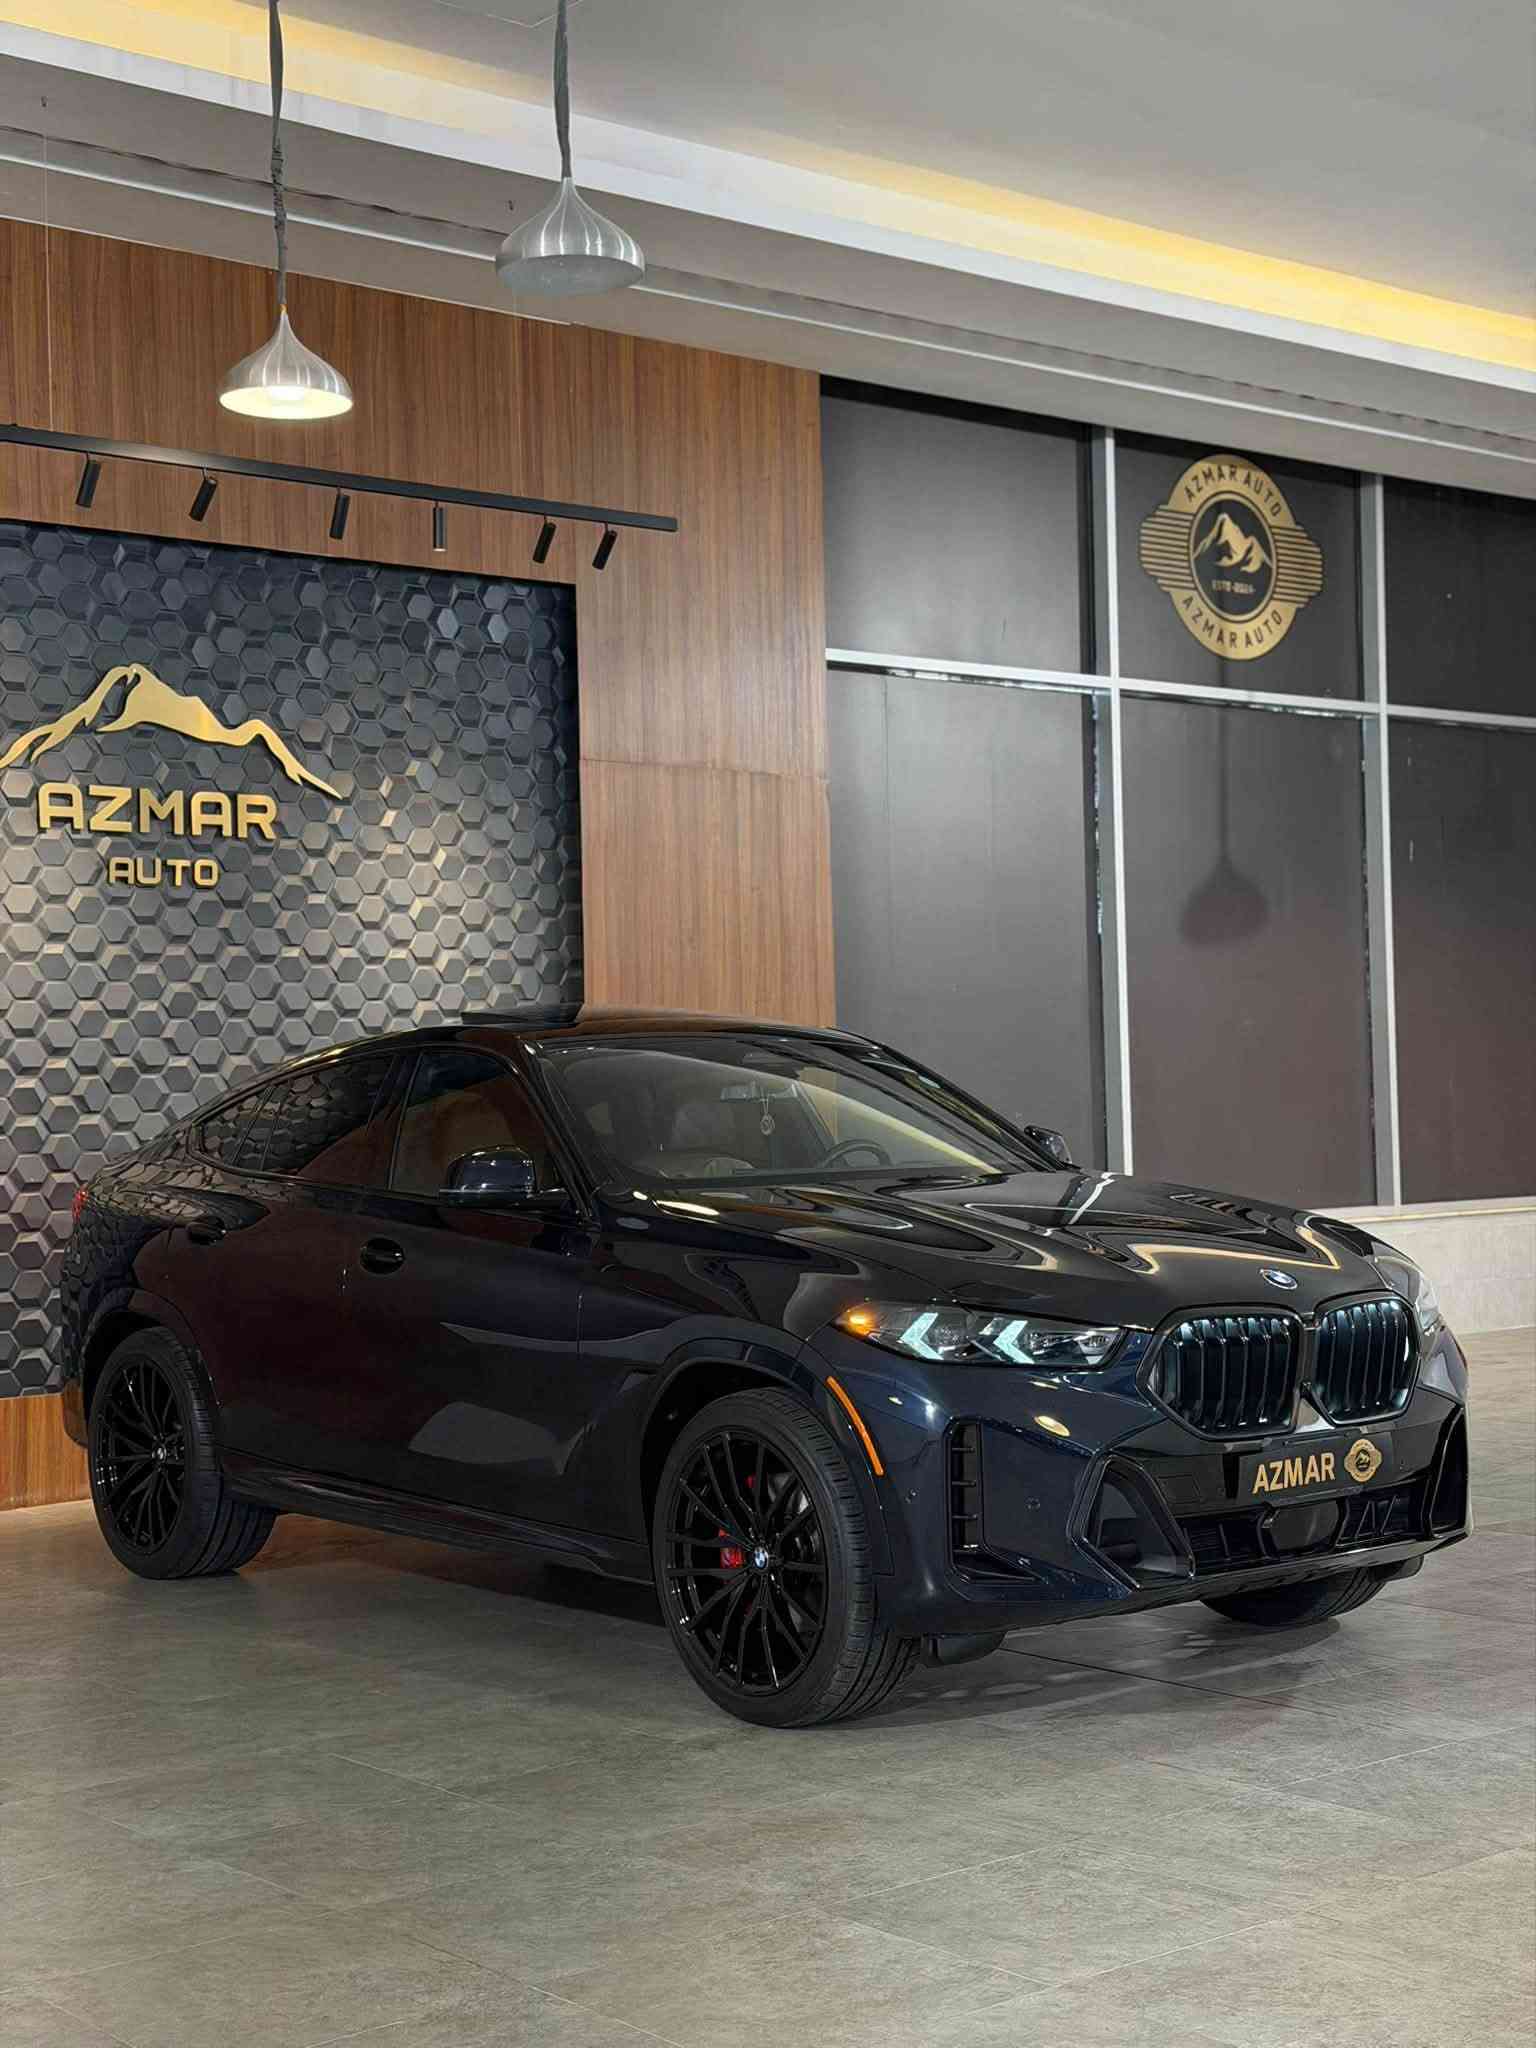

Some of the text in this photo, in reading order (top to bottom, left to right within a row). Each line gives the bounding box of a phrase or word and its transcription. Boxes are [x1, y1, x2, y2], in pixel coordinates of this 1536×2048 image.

[1183, 465, 1282, 517] AZMAR AUTO
[1181, 597, 1283, 648] AZMAR AUTO
[38, 782, 278, 839] AZMAR
[109, 857, 219, 887] AUTO
[1252, 1452, 1336, 1494] AZMAR
